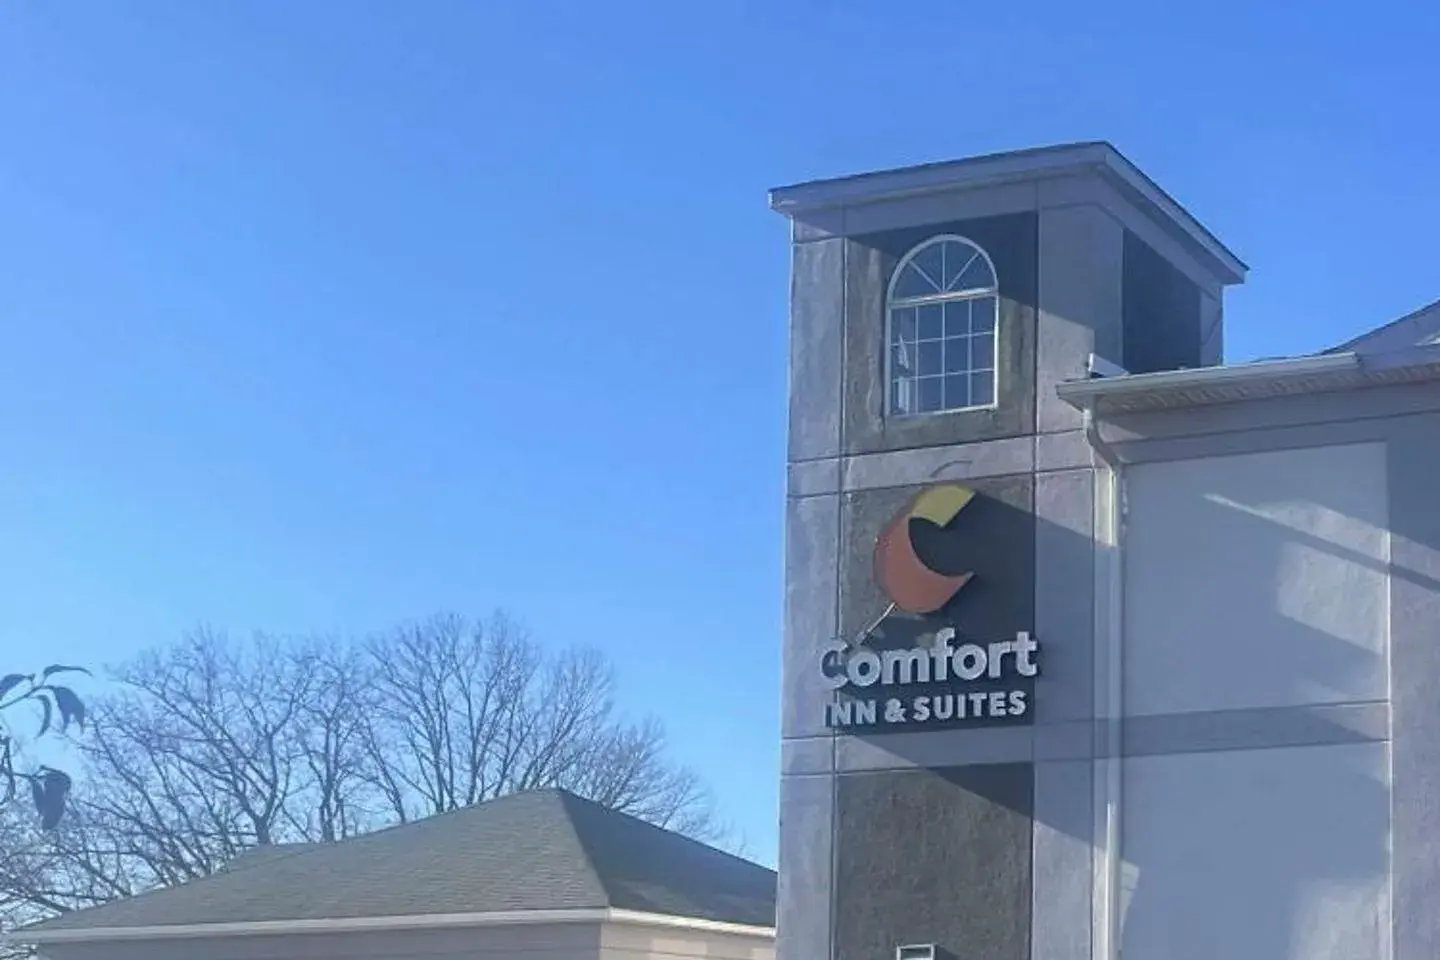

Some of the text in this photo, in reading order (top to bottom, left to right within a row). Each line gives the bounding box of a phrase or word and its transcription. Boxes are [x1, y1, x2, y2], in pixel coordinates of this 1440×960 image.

[820, 628, 1037, 689] Comfort
[826, 691, 1026, 727] INN & SUITES
